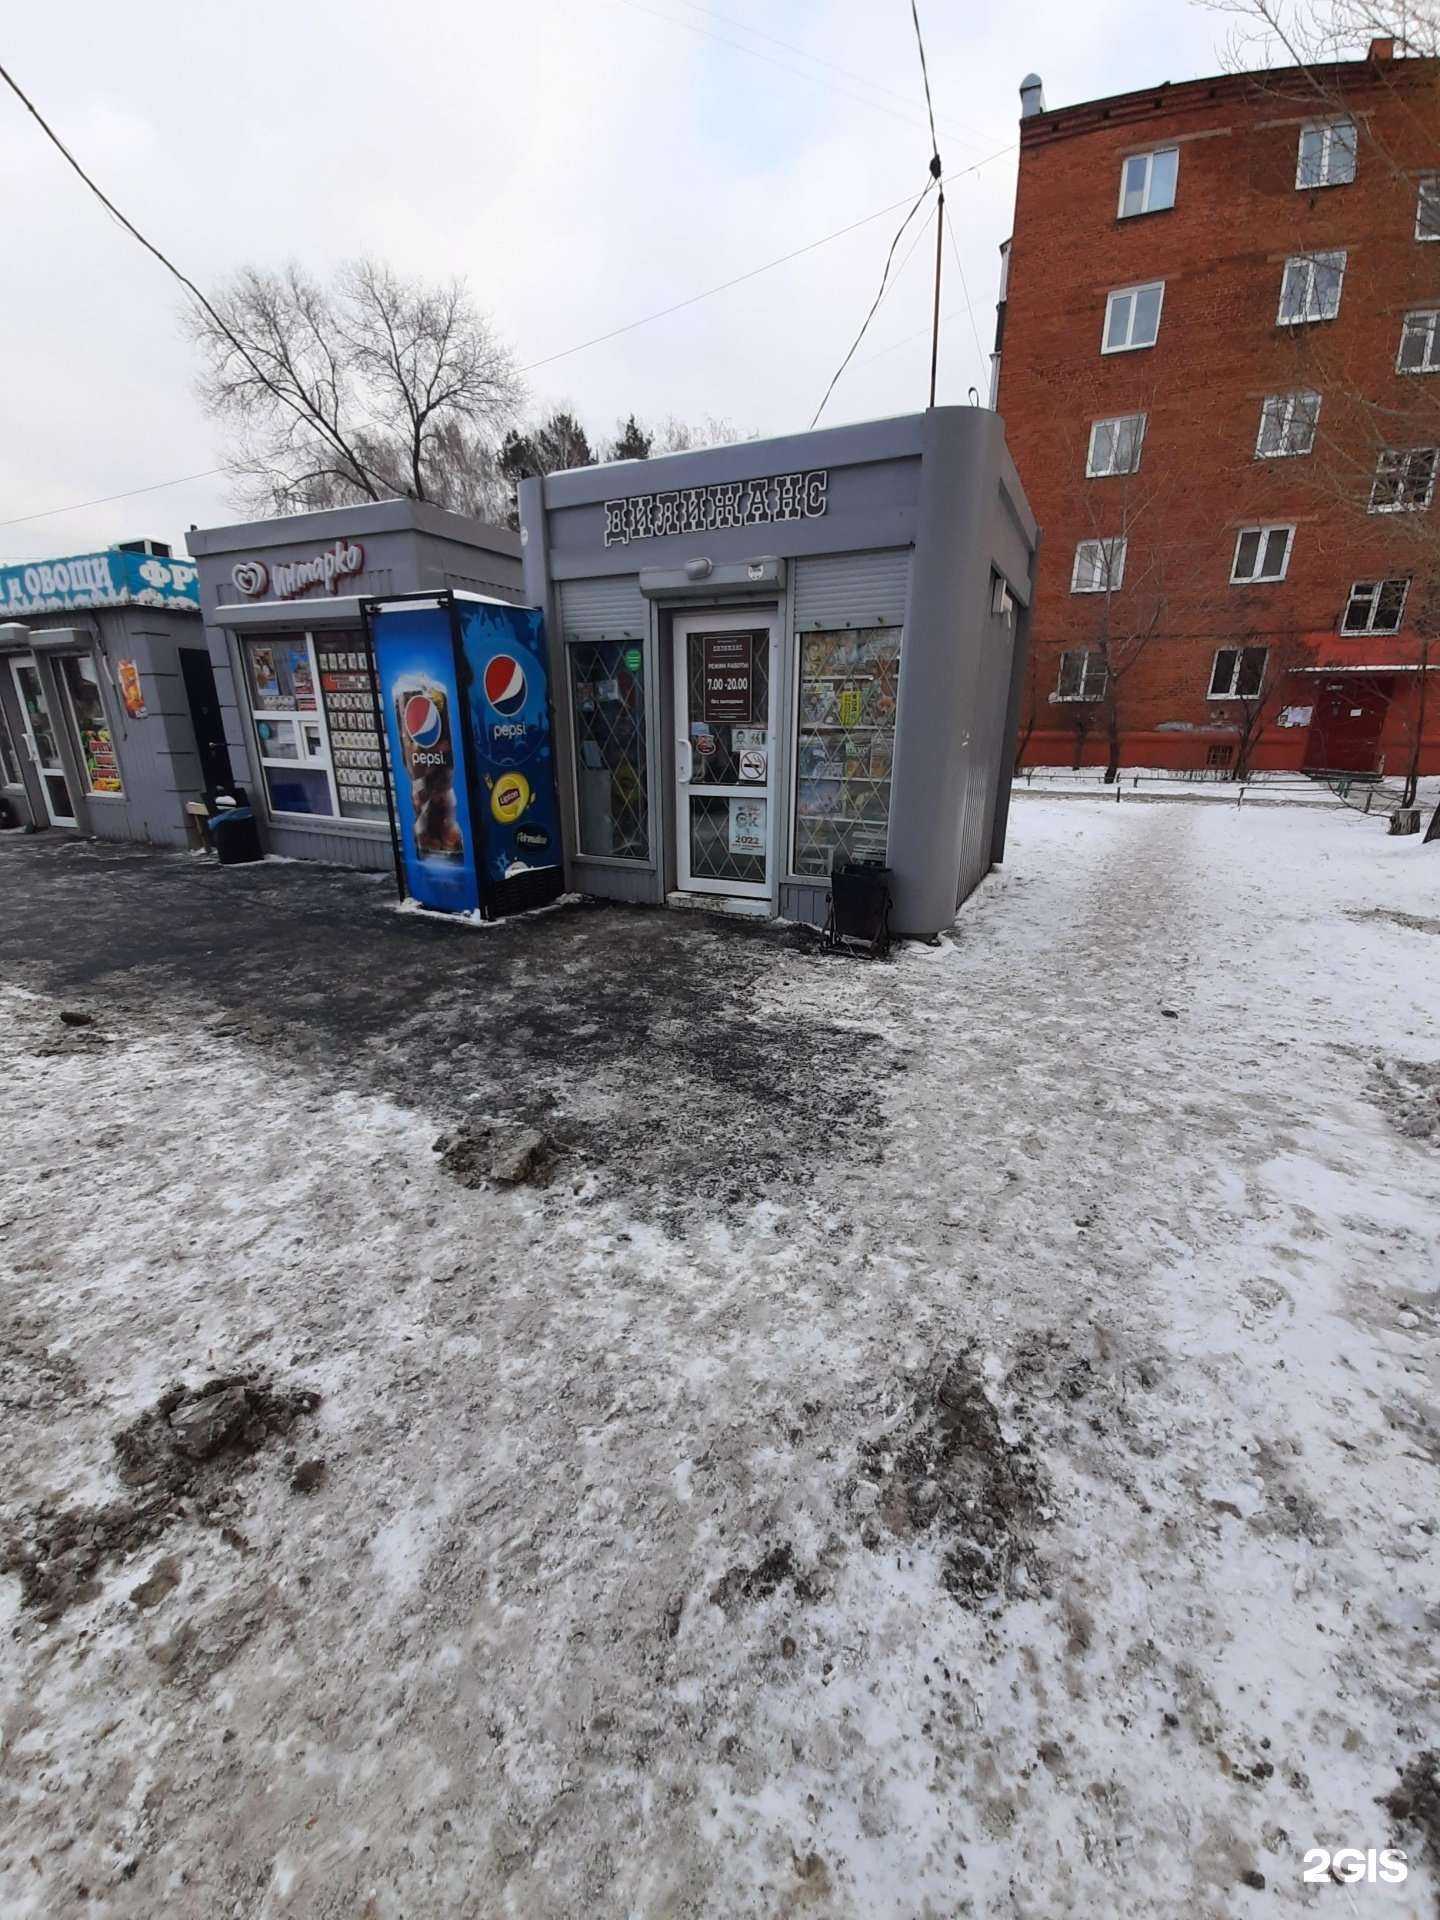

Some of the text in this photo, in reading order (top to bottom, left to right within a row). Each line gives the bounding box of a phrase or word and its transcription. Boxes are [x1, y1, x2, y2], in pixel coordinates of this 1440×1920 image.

[605, 471, 827, 547] ДИЛИЖАНС
[25, 557, 113, 595] ОВОЩИ
[139, 560, 199, 590] ФР
[493, 722, 527, 739] pepsi
[411, 751, 444, 767] pepsi
[735, 835, 759, 845] 2022
